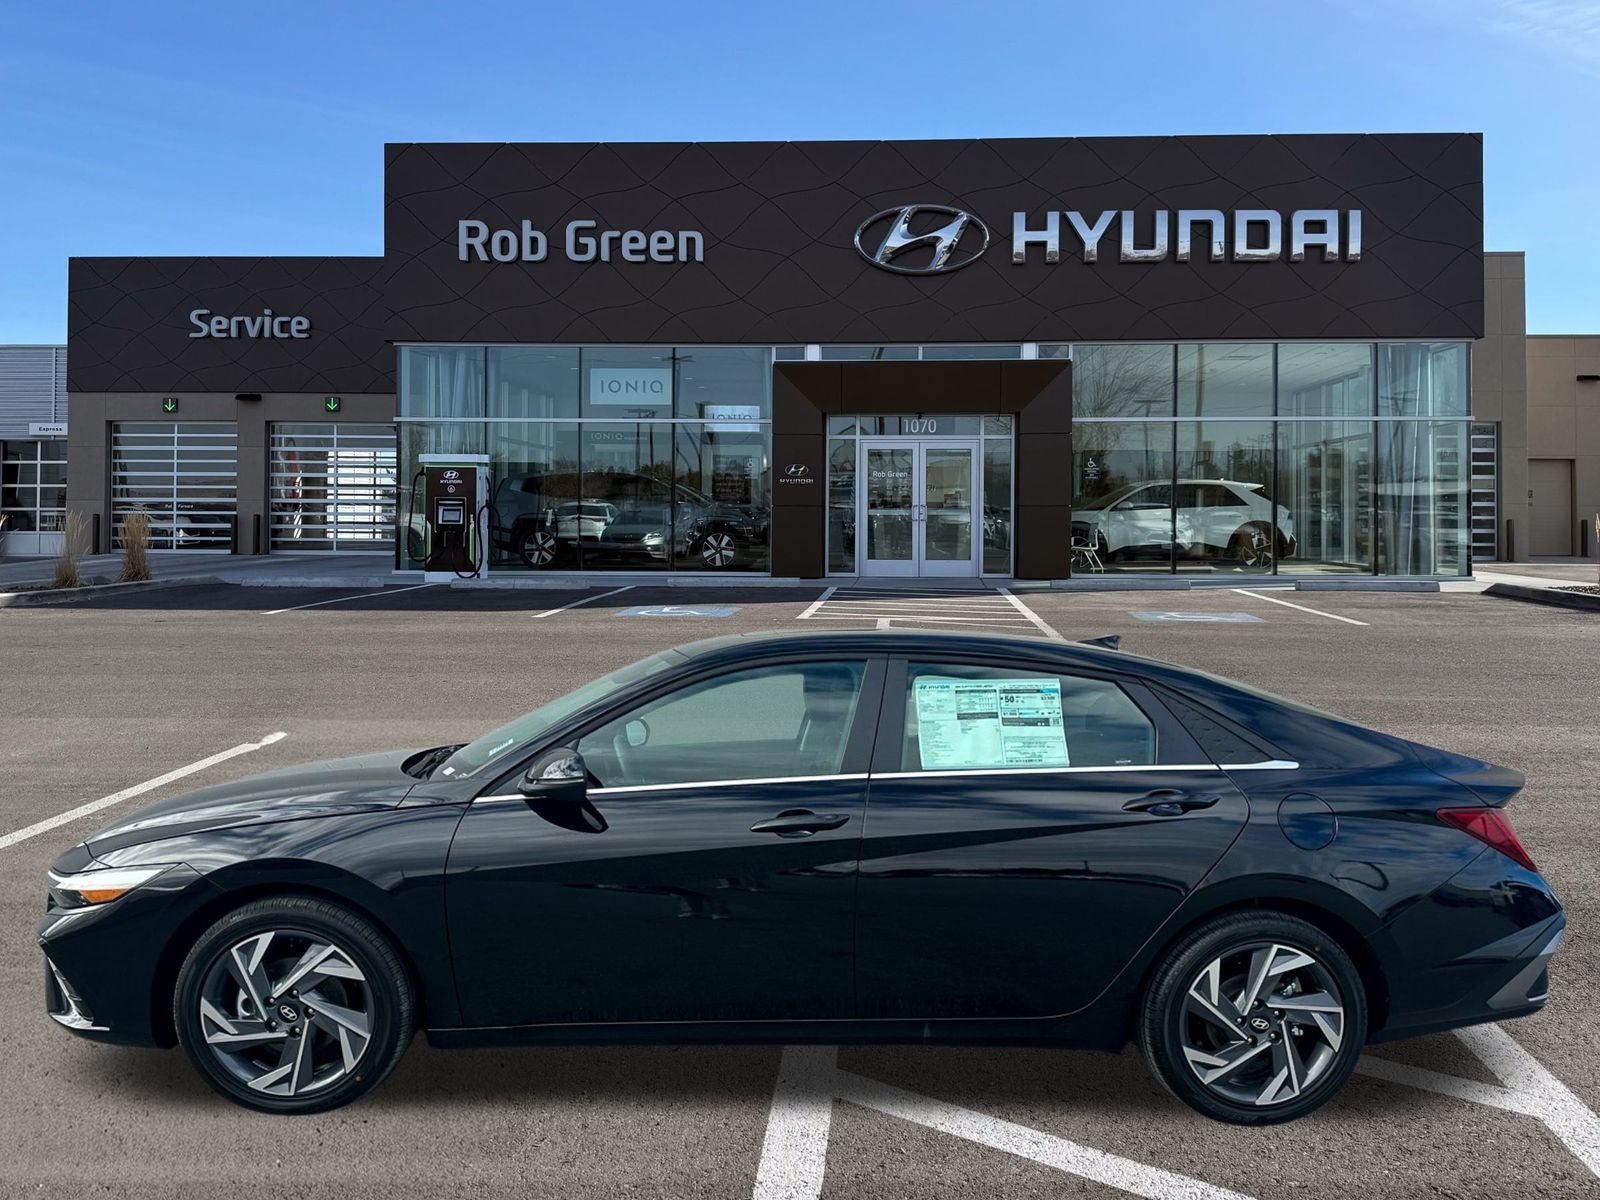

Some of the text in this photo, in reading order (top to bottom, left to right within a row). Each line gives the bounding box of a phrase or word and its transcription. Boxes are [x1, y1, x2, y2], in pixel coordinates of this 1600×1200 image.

[458, 219, 704, 262] Rob Green
[1012, 209, 1361, 264] HYUNDAI
[189, 308, 310, 338] Service
[600, 379, 664, 394] IONIQ
[903, 419, 937, 433] 1070
[591, 432, 624, 440] IONIQ
[872, 470, 908, 478] Rob Green
[1004, 695, 1015, 703] 50
